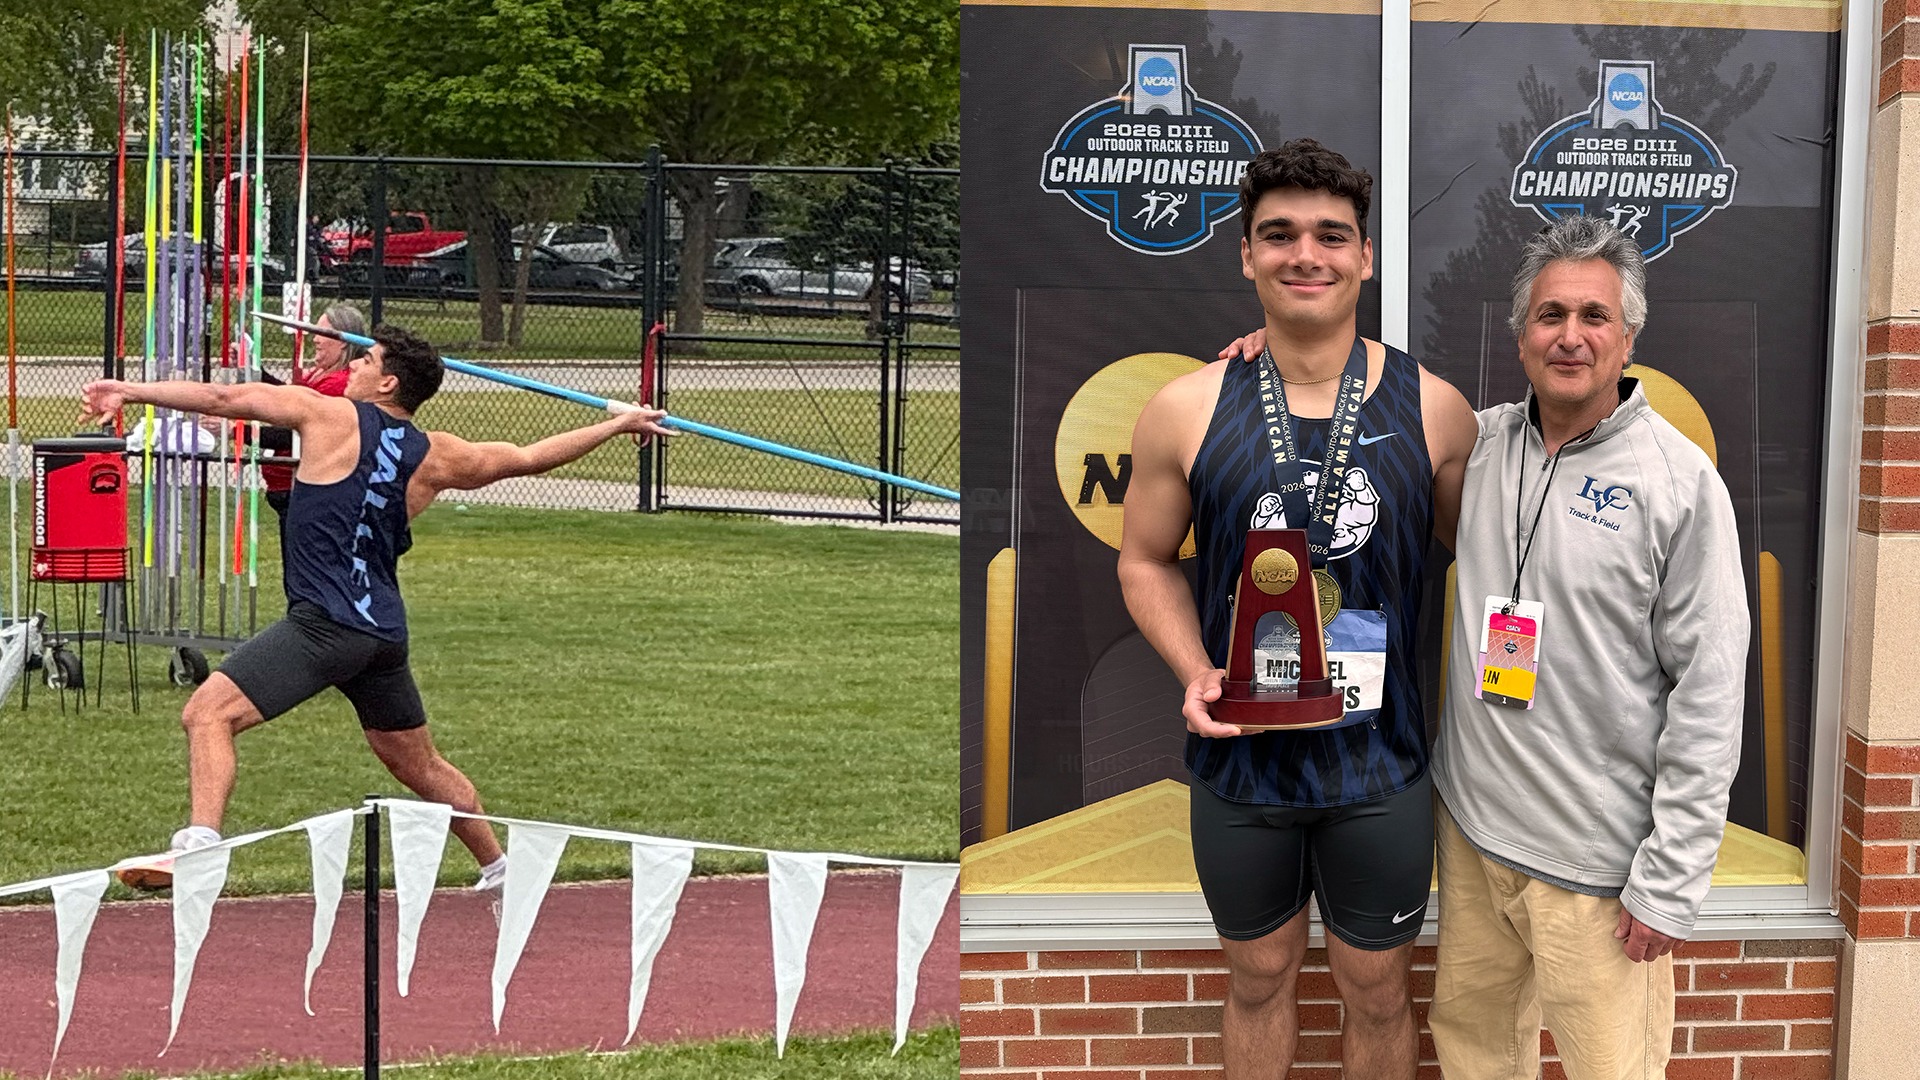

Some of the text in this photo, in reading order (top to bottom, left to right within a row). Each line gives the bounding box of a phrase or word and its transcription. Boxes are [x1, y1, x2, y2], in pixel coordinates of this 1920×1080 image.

[1142, 76, 1176, 87] NCAA
[1612, 91, 1643, 101] NCAA
[1103, 124, 1213, 138] 2026 DIII
[1087, 138, 1229, 153] OUTDOOR TRACK & FIELD
[1573, 138, 1677, 152] 2026 DIII
[1556, 152, 1692, 167] OUTDOOR TRACK & FIELD
[1049, 157, 1251, 186] CHAMPIONSHIP
[1519, 171, 1729, 199] CHAMPIONSHIPS
[1342, 374, 1352, 393] FIELD
[1274, 376, 1286, 413] OUTDOOR
[1280, 413, 1291, 435] TRACK
[1286, 441, 1296, 461] FIELD
[1335, 401, 1347, 422] TRACK
[1326, 420, 1342, 459] OUTDOOR
[1322, 378, 1365, 525] ALL-AMERICAN
[1281, 481, 1305, 493] 2026
[1317, 467, 1330, 501] DIVISION
[36, 457, 45, 546] BODYARMOR
[1313, 500, 1325, 522] NCAA
[352, 427, 405, 627] VALLEY
[1568, 506, 1620, 531] Track & Field
[1308, 544, 1329, 555] 026
[1254, 569, 1296, 583] NCAA
[1505, 624, 1521, 632] COACH
[1266, 659, 1347, 680] MICEL
